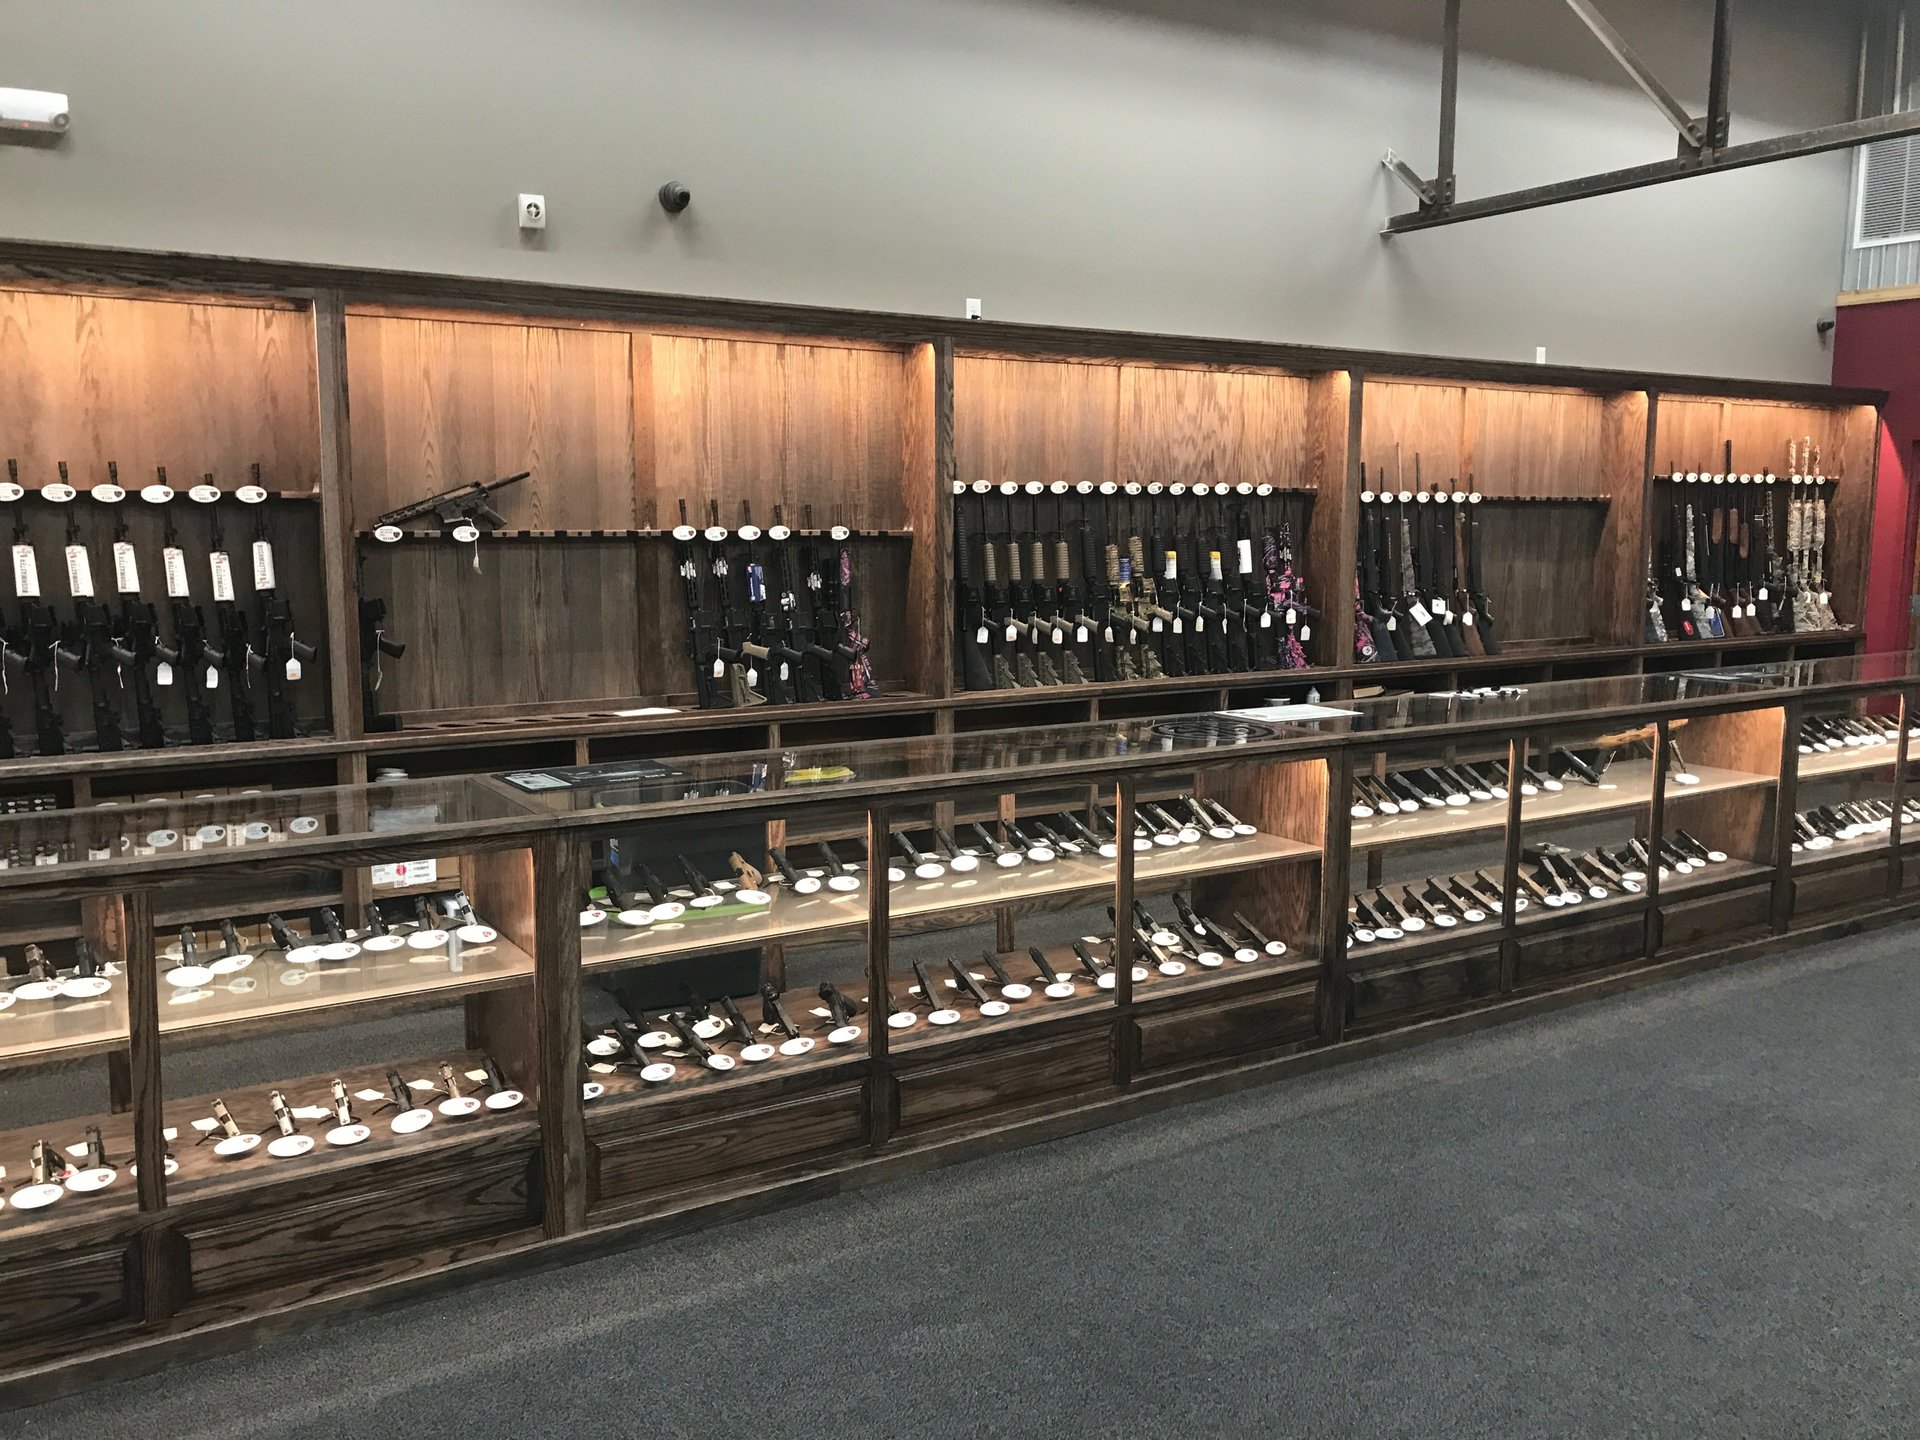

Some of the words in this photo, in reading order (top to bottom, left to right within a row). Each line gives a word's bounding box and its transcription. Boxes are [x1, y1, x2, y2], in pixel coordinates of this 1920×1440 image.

[19, 559, 29, 593] BUSHMASTER
[70, 560, 80, 593] BUSHMASTER
[118, 556, 127, 590] BUSHMASTER
[167, 561, 177, 594] BUSHMASTER
[257, 545, 267, 577] BUSHMASTER
[215, 564, 224, 598] BUSHMASTER
